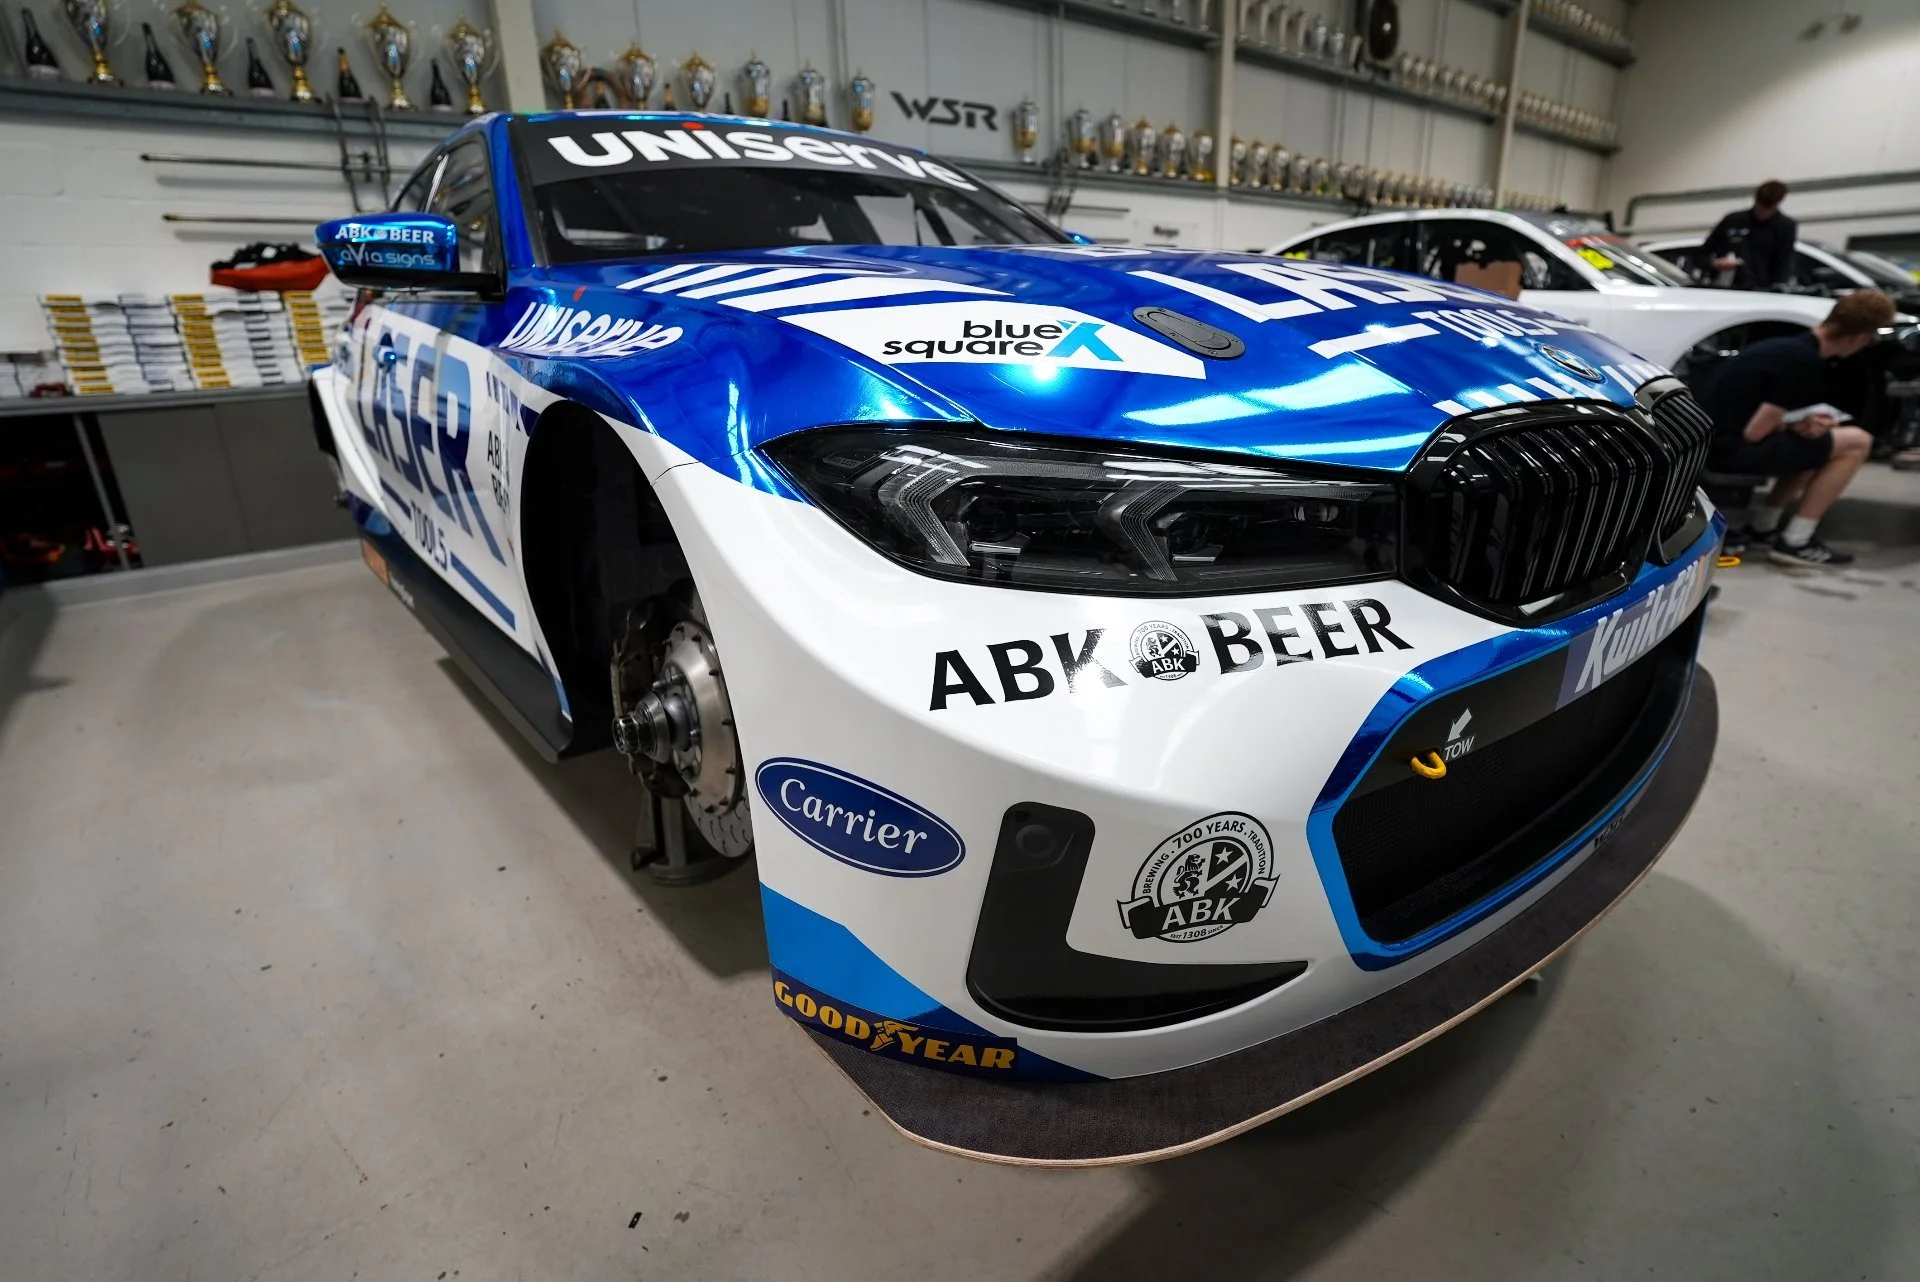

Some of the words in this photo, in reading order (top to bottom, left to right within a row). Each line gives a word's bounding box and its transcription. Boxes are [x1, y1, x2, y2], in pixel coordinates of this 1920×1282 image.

[889, 90, 998, 131] WSR
[335, 225, 372, 239] ABK
[389, 228, 435, 244] BEER
[385, 253, 436, 268] signs
[963, 319, 1063, 340] blue
[1410, 308, 1559, 342] TOOLS
[882, 338, 1044, 359] square
[410, 499, 448, 573] TOOLS
[928, 627, 1129, 712] ABK
[1198, 597, 1416, 675] BEER
[1151, 657, 1186, 674] ABK
[1444, 735, 1475, 761] TOW
[780, 778, 928, 854] Carrier
[1142, 852, 1170, 894] BREWING
[1172, 827, 1203, 849] 700
[1205, 820, 1246, 835] YEARS
[1248, 829, 1266, 875] TRADITION
[1161, 896, 1241, 931] ABK
[1183, 928, 1207, 940] 1308
